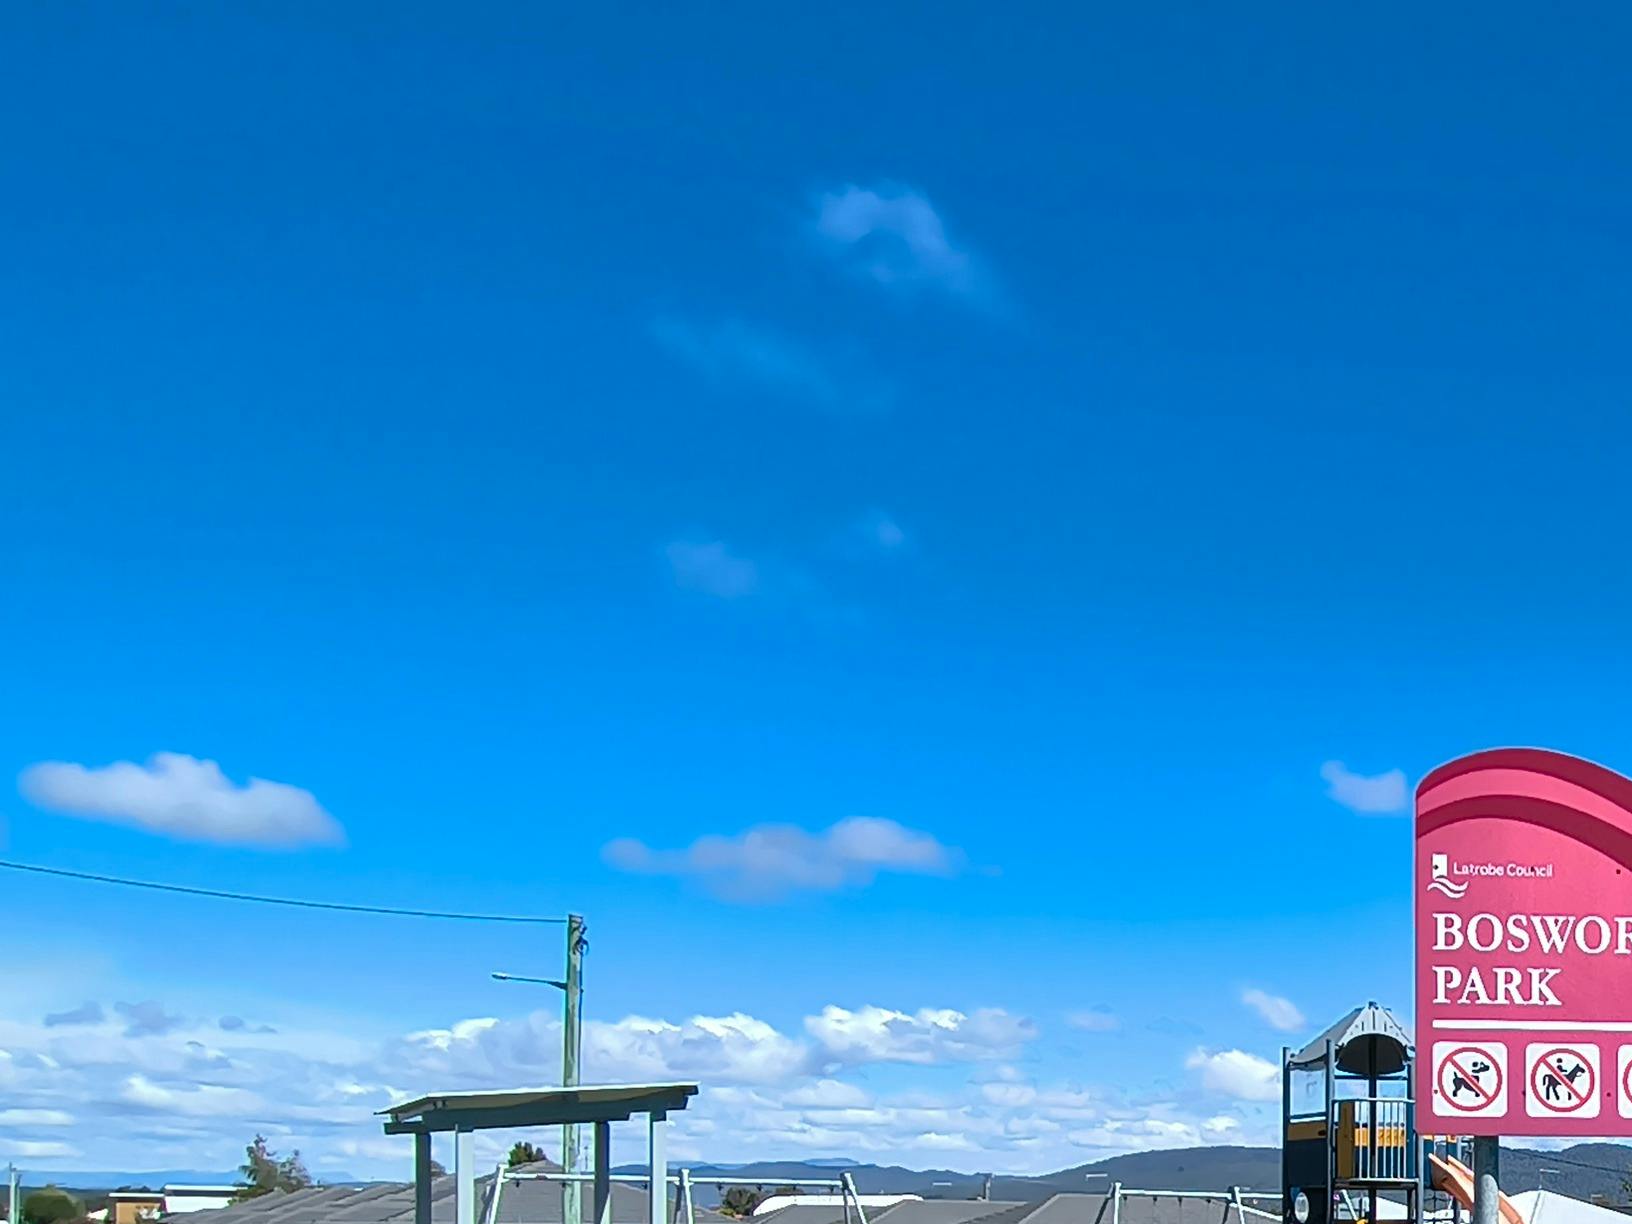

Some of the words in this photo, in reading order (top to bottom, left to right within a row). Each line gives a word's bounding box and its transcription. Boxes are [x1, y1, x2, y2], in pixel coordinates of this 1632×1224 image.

[1453, 862, 1505, 876] Latrobe
[1506, 863, 1554, 877] Council
[1431, 965, 1563, 1006] PARK
